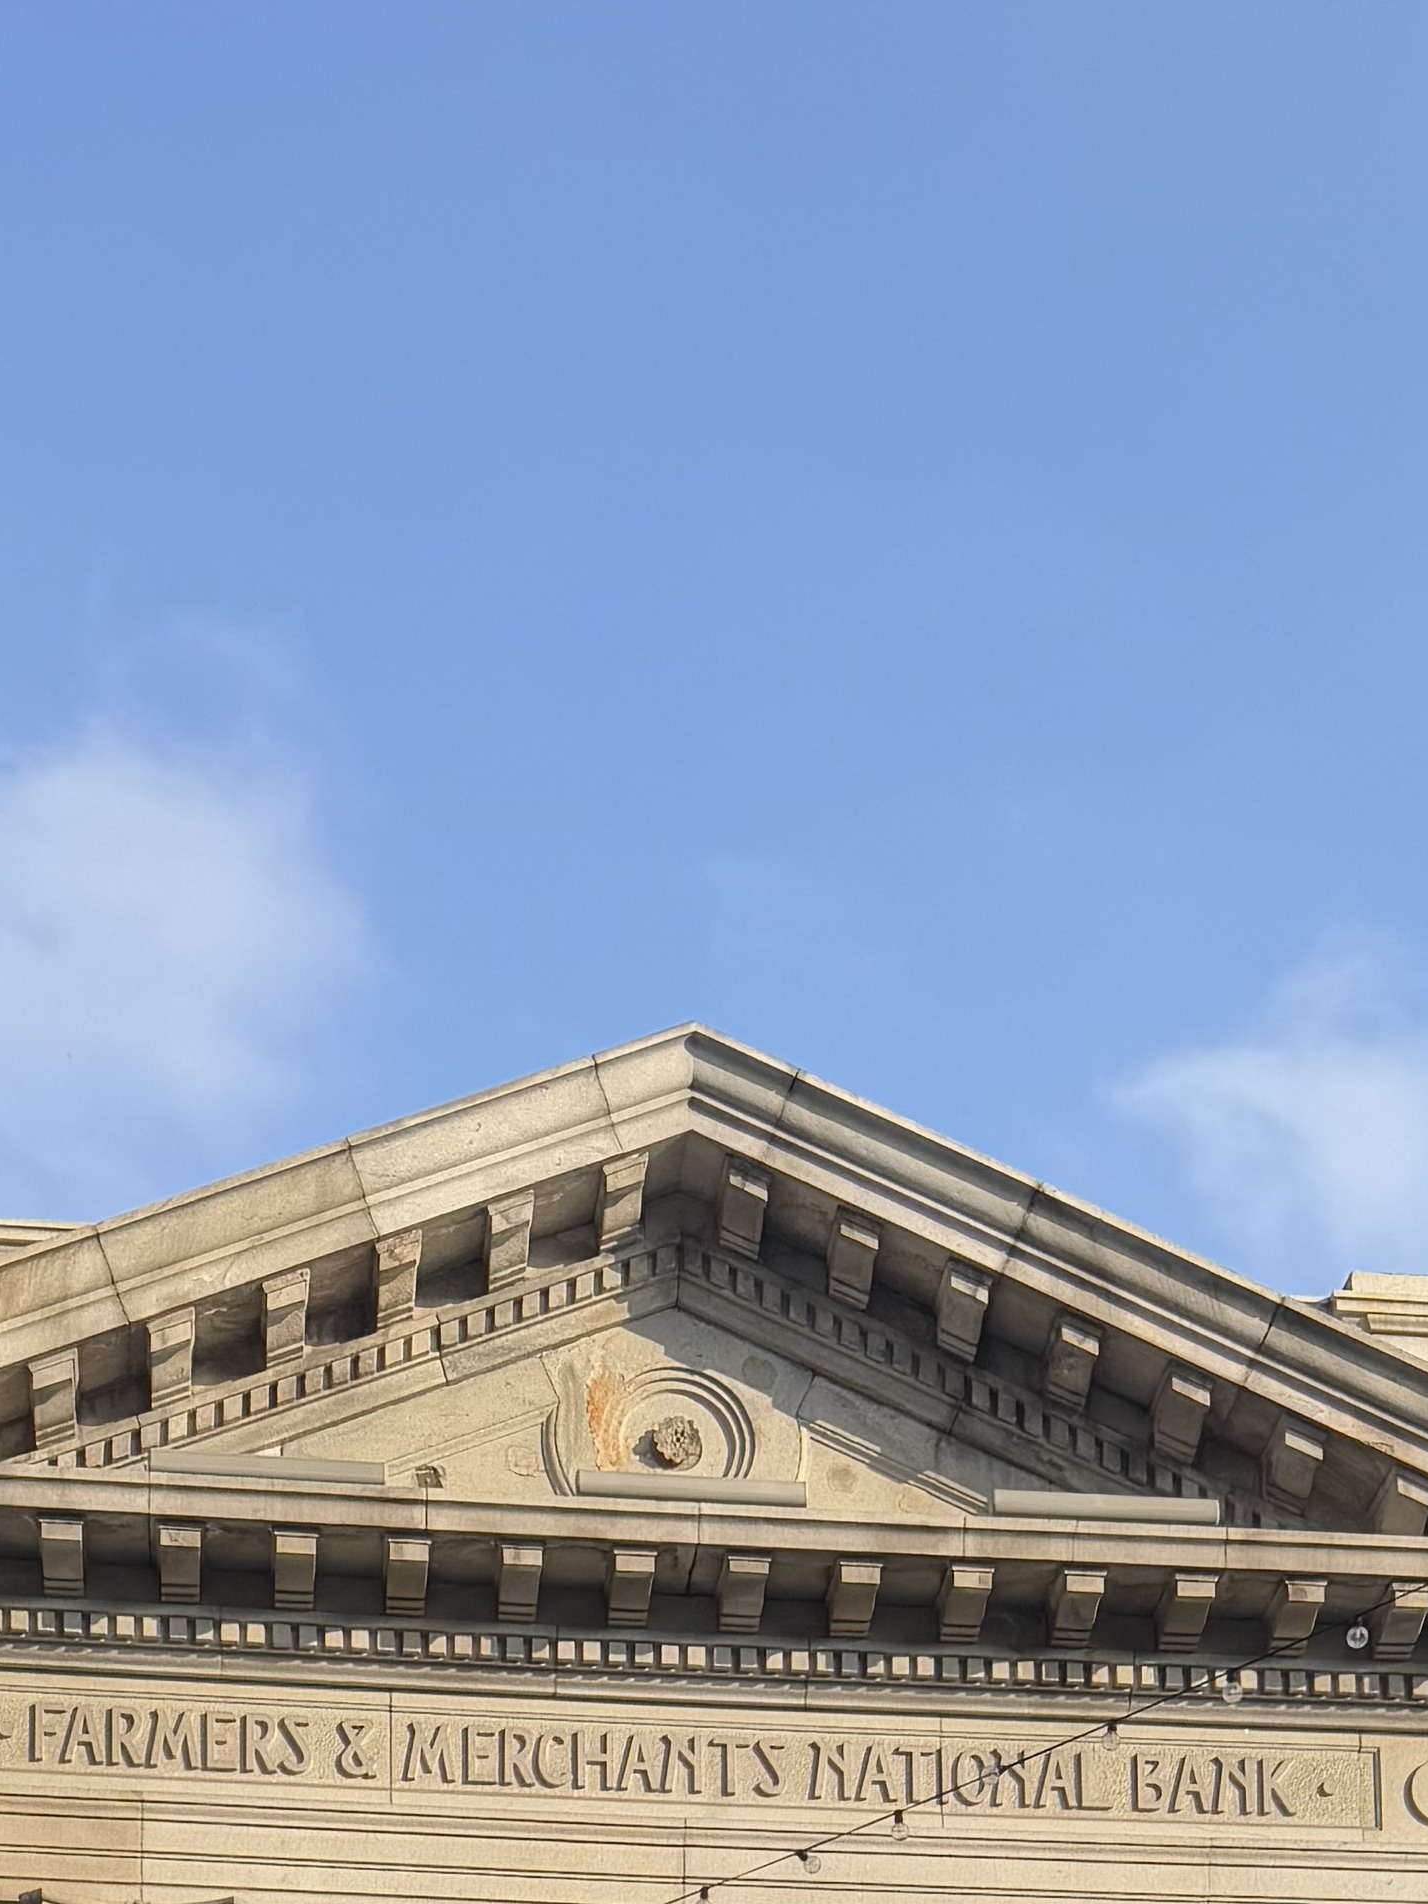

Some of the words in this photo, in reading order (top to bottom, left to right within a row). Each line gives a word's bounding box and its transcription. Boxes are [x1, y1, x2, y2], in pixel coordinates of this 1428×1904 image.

[26, 1702, 310, 1776] FARMERS
[334, 1723, 379, 1781] &
[401, 1720, 785, 1798] MERCHANTS
[807, 1741, 1114, 1812] NATIONAL
[1129, 1752, 1297, 1818] BANK
